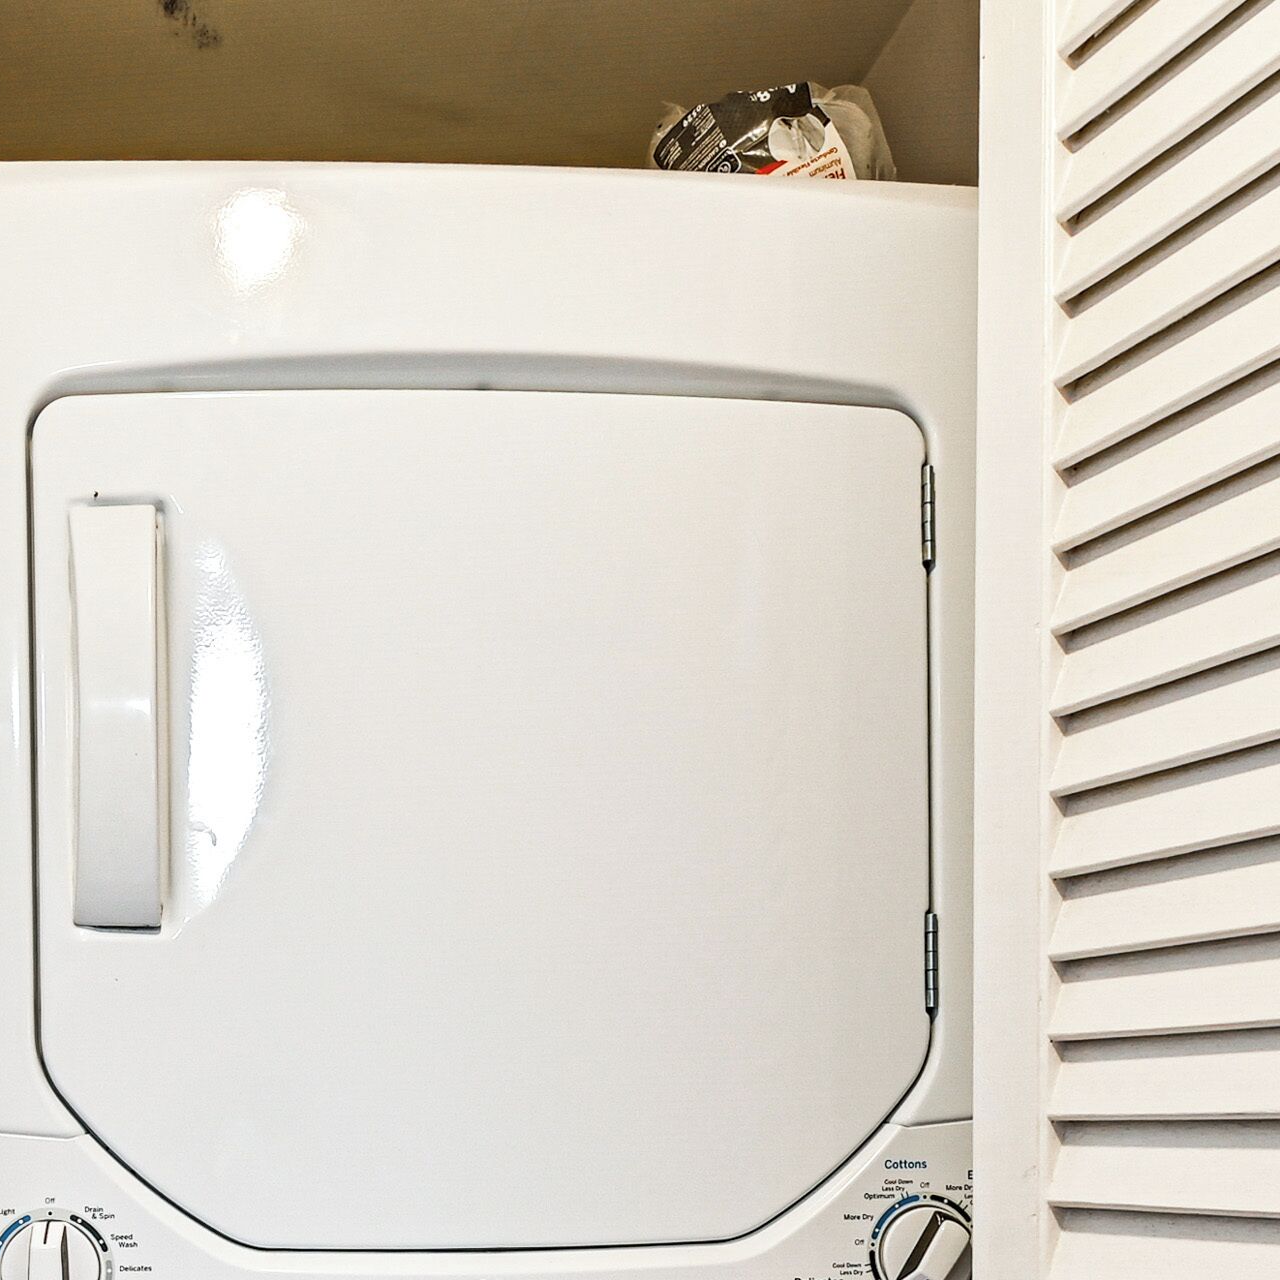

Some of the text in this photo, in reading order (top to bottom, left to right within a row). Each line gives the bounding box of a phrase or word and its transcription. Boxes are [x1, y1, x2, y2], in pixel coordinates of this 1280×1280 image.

[809, 157, 842, 177] Aluminum
[884, 1159, 927, 1170] Cottons
[862, 1213, 874, 1221] Dry
[110, 1234, 133, 1242] Speed
